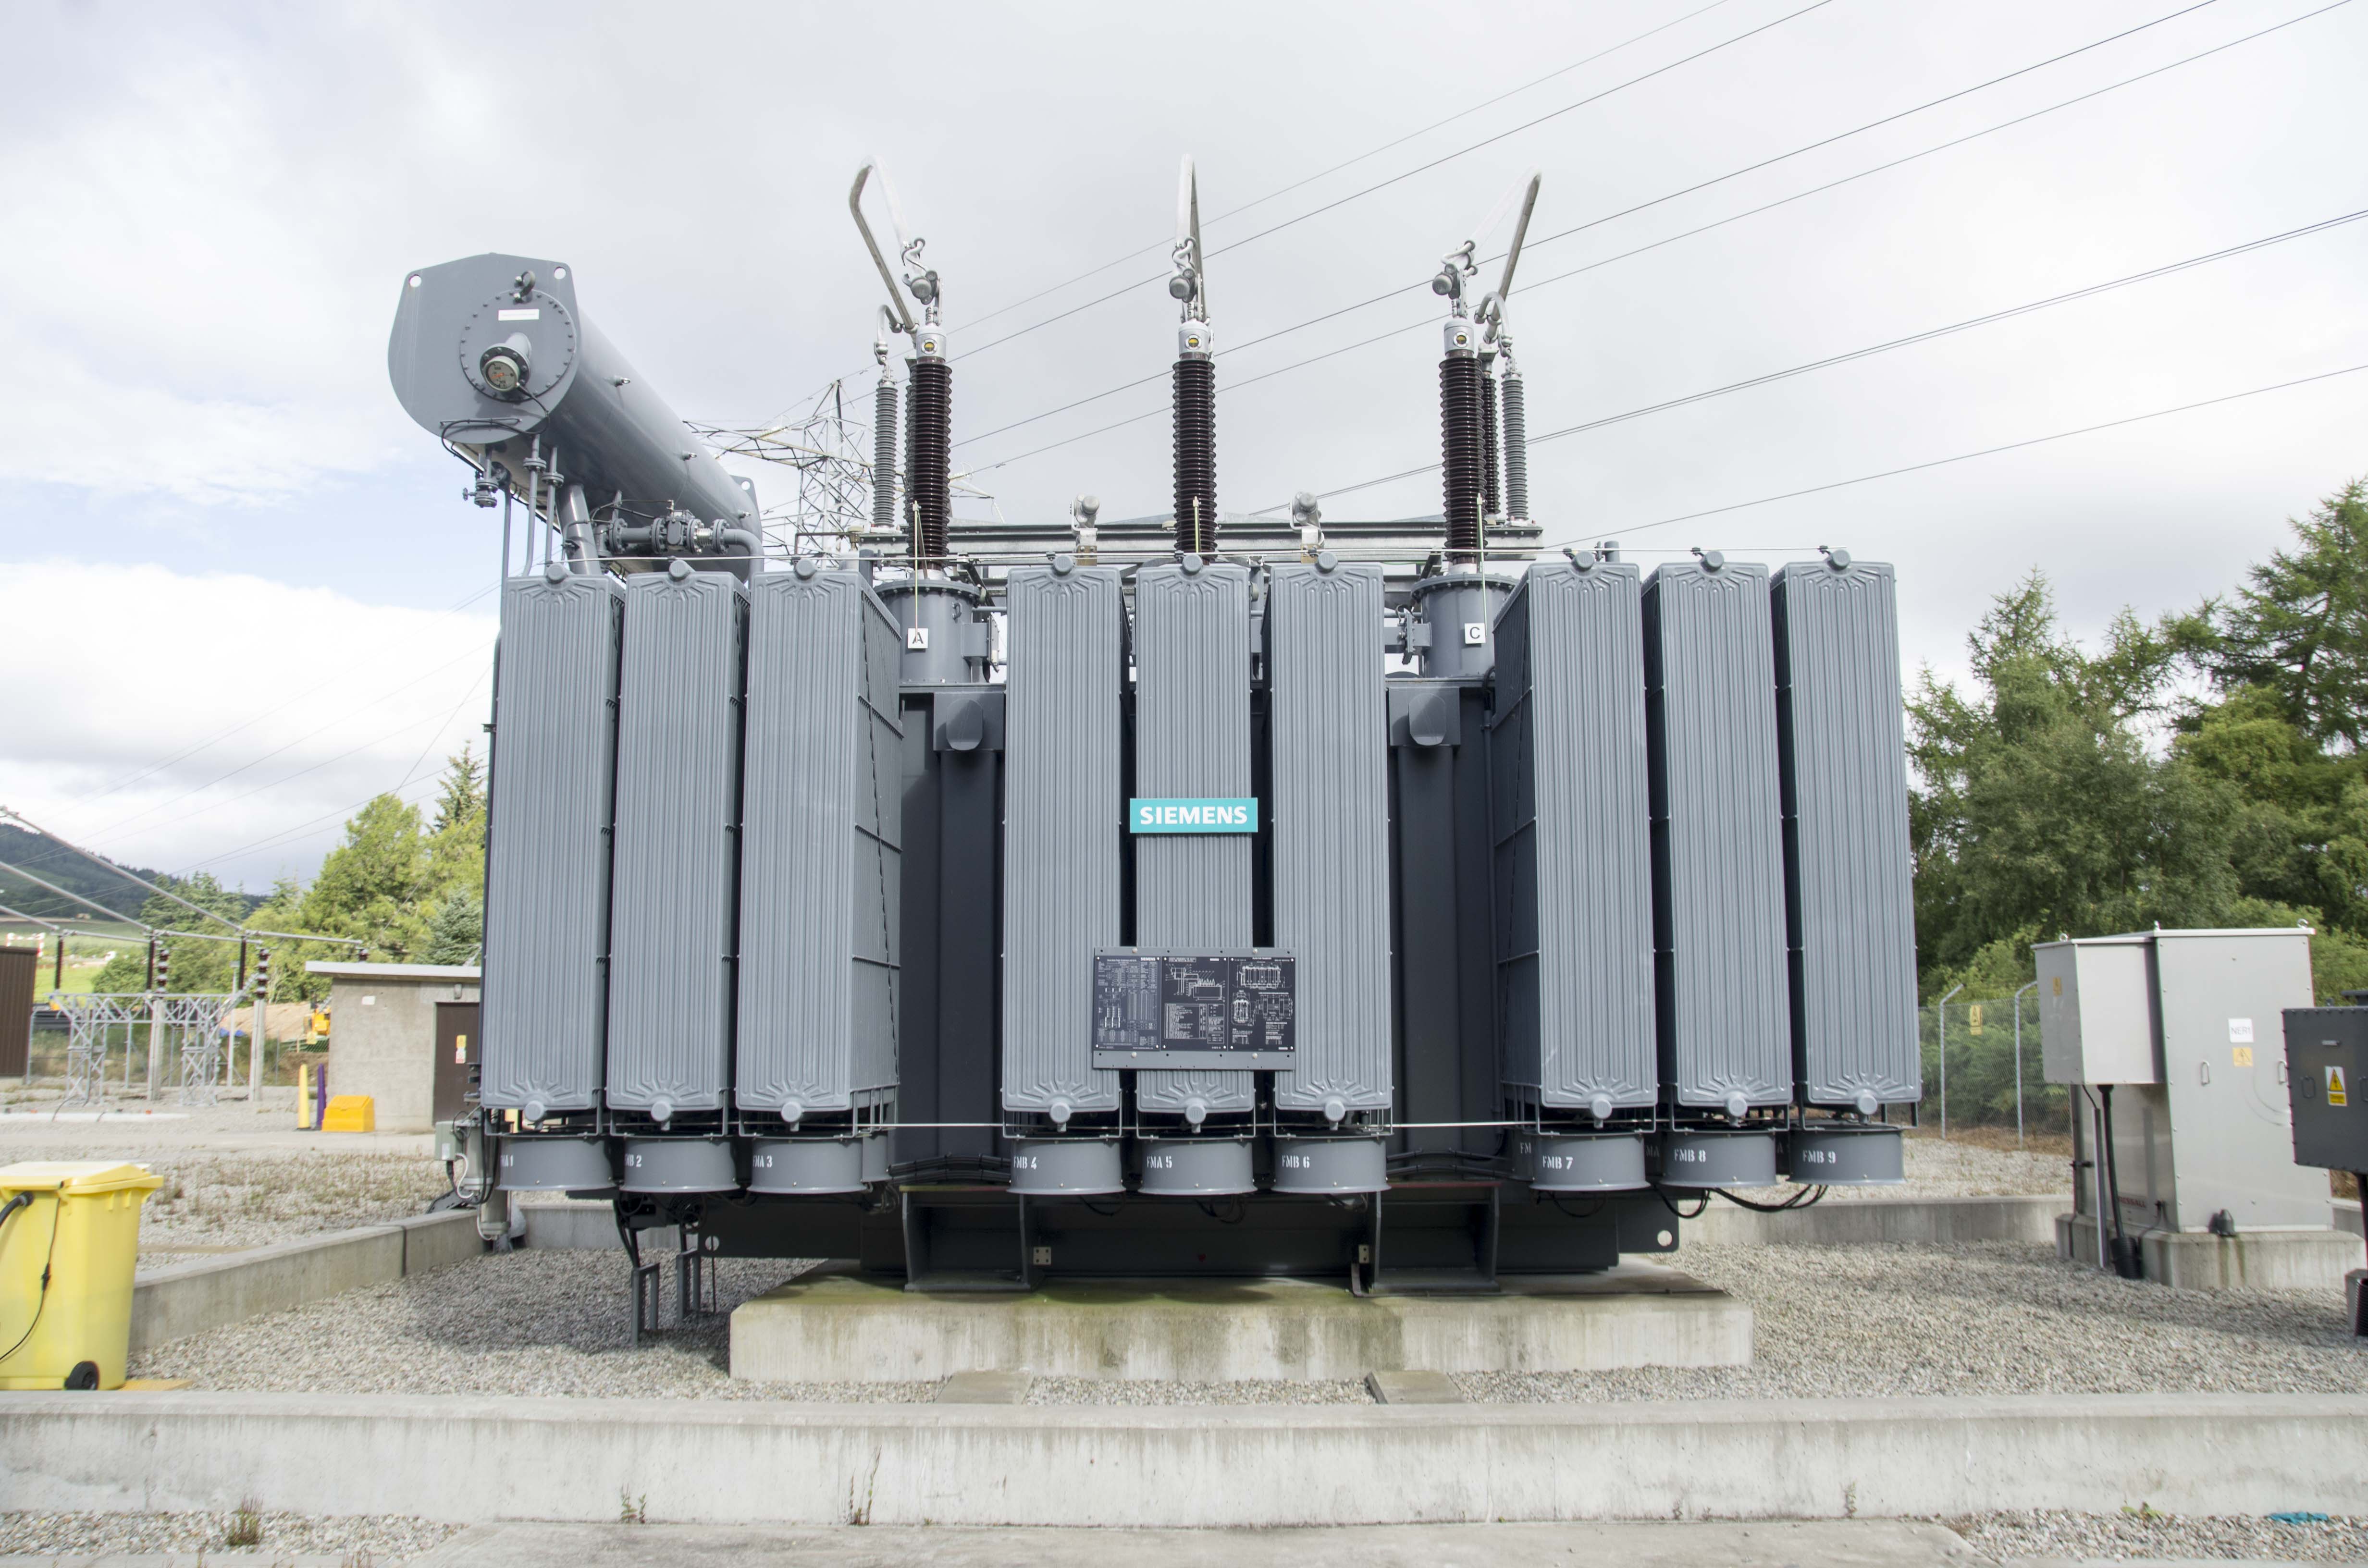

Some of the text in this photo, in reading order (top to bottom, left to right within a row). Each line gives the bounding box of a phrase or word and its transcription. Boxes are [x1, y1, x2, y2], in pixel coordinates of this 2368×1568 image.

[912, 632, 924, 644] A
[1470, 627, 1480, 639] C
[1139, 806, 1247, 825] SIEMENS
[2231, 1027, 2251, 1035] NER1
[1520, 1142, 1531, 1154] FM
[1645, 1145, 1660, 1157] MA
[510, 1155, 514, 1166] 1
[636, 1154, 642, 1167] 2
[752, 1155, 773, 1168] FMA 3
[1282, 1155, 1310, 1169] FMB 6
[1674, 1149, 1706, 1162] FMB 8
[1802, 1150, 1836, 1164] FMB 9
[1013, 1156, 1037, 1170] FMB 4
[1147, 1156, 1172, 1169] FMA 5
[1542, 1155, 1573, 1170] FMB 7
